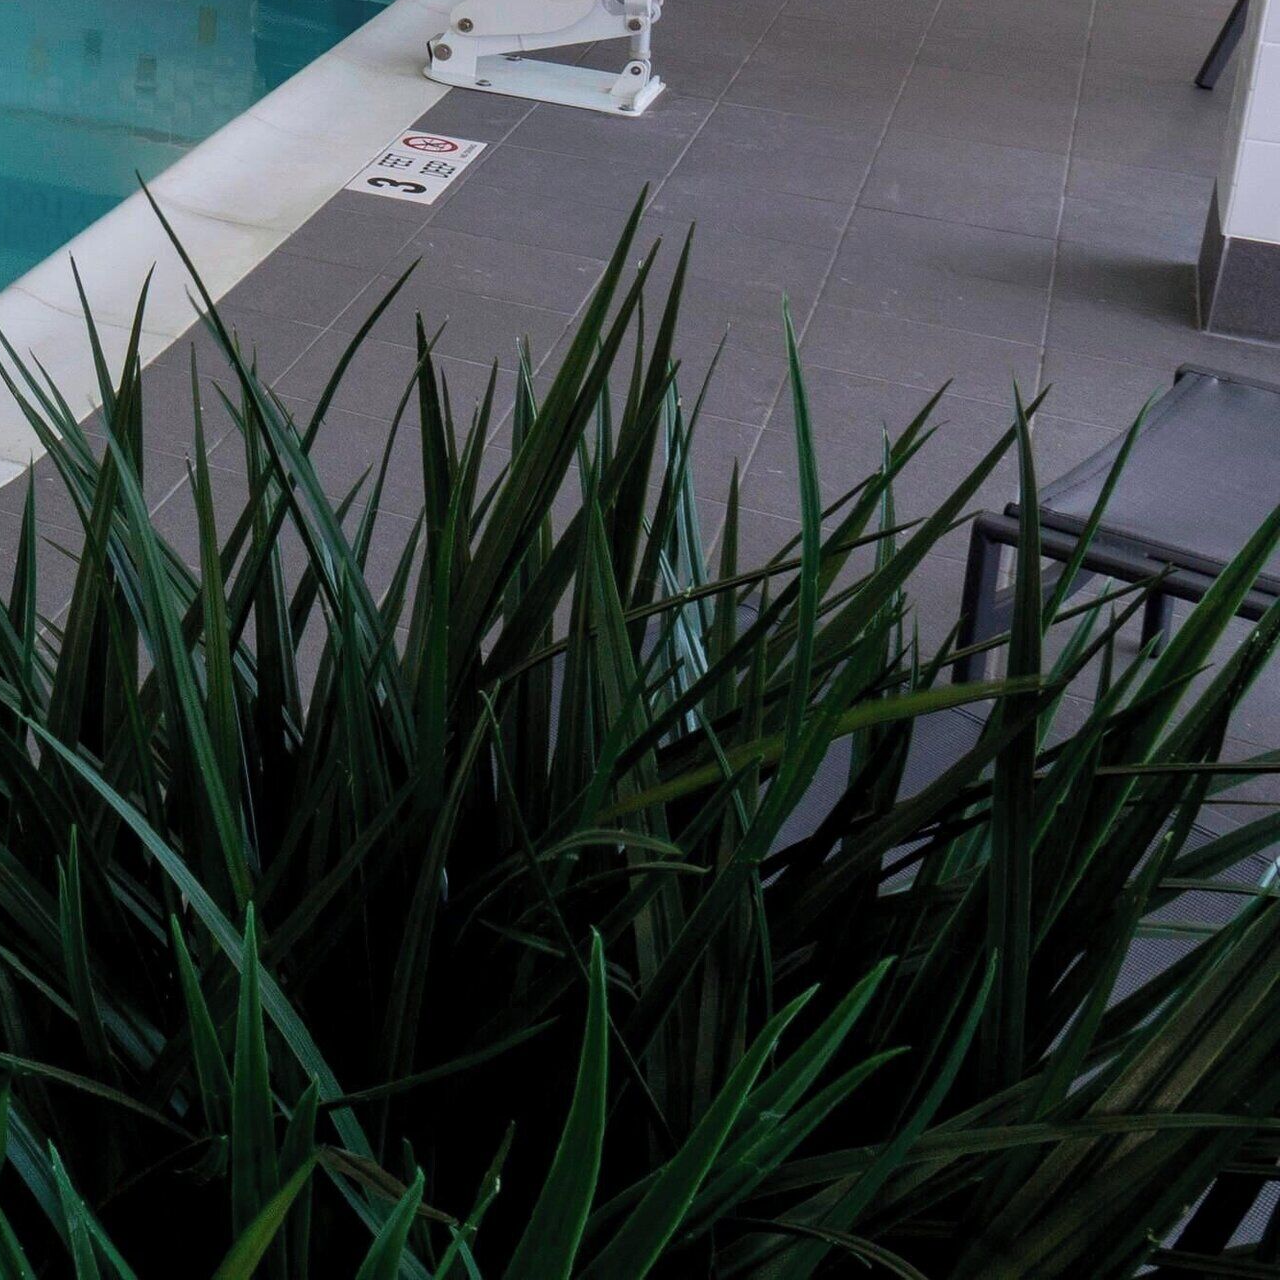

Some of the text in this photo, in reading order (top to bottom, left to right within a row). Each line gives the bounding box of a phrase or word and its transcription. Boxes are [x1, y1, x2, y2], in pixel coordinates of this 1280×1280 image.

[378, 153, 415, 170] FEET
[420, 160, 456, 178] DEEP
[367, 177, 427, 194] 3
